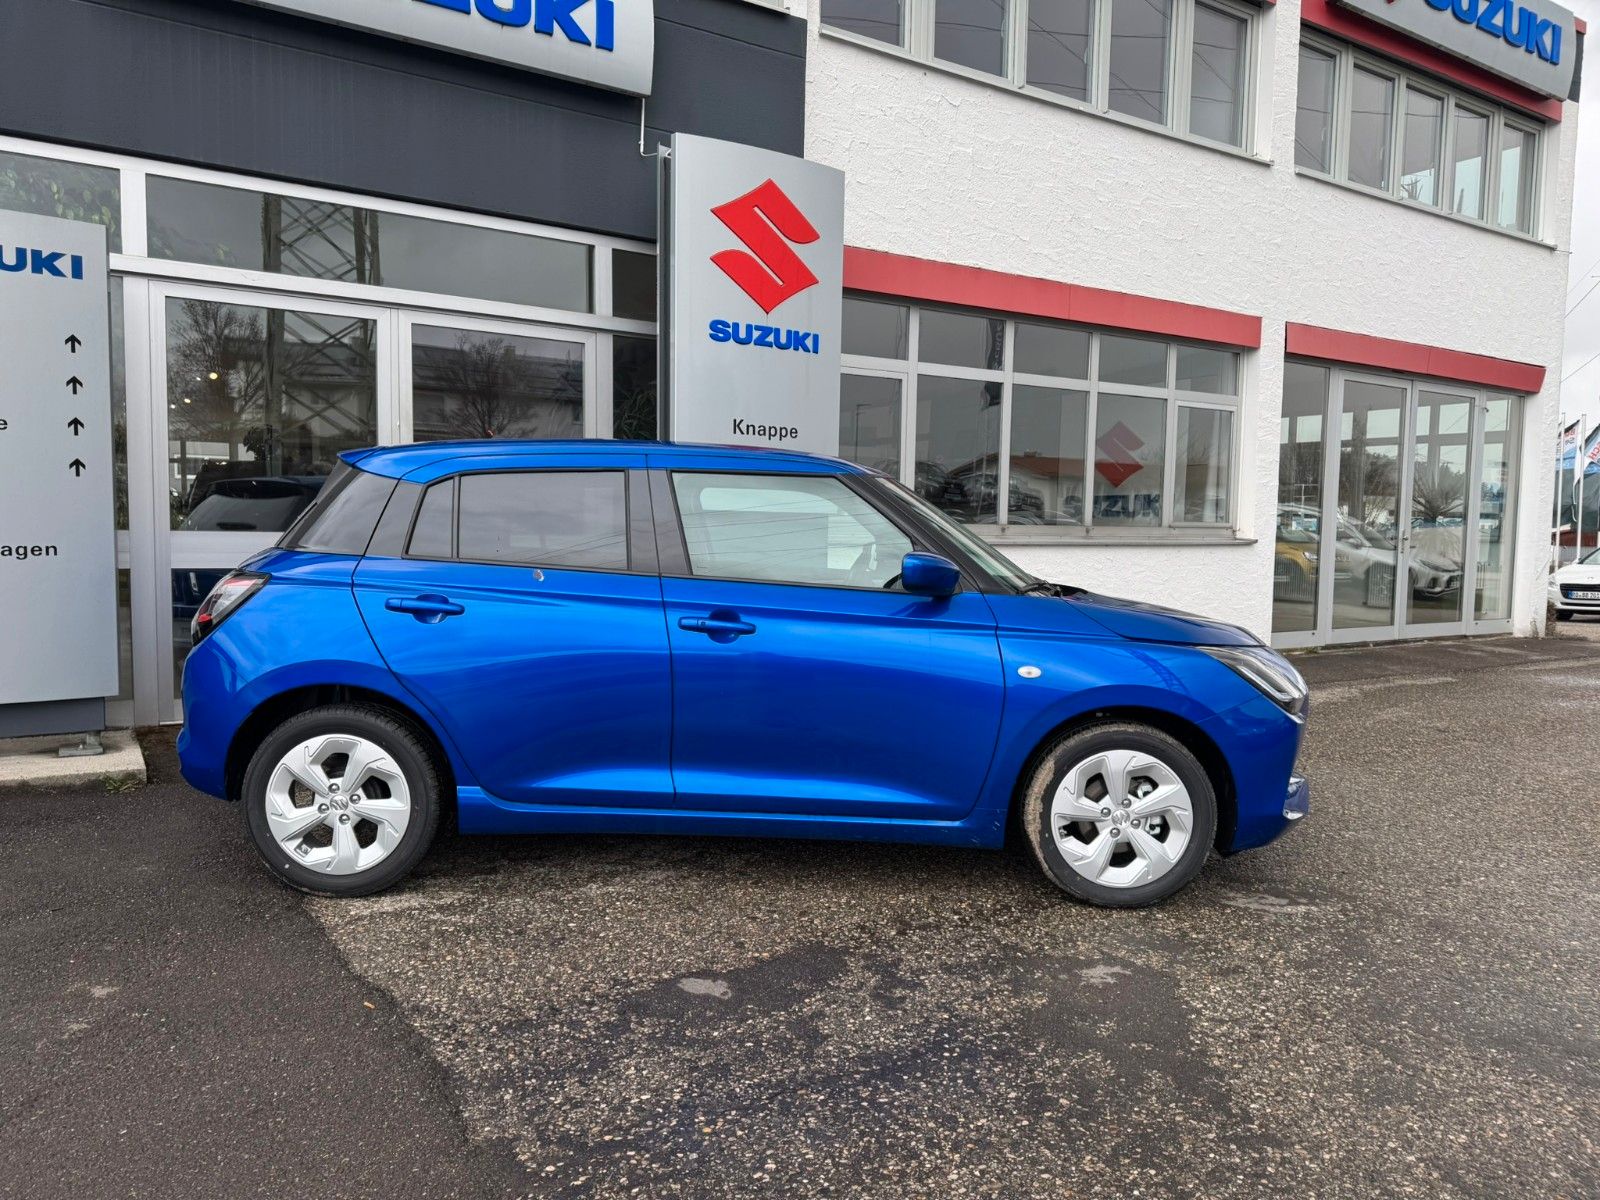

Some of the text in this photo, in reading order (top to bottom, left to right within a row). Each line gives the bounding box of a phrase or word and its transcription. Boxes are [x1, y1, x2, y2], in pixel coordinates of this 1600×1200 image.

[411, 0, 615, 52] UKI
[1424, 0, 1562, 65] UZUKI
[0, 246, 84, 280] UKI
[708, 319, 820, 354] SUZUKI
[733, 418, 799, 441] Knappe
[0, 545, 58, 560] agen
